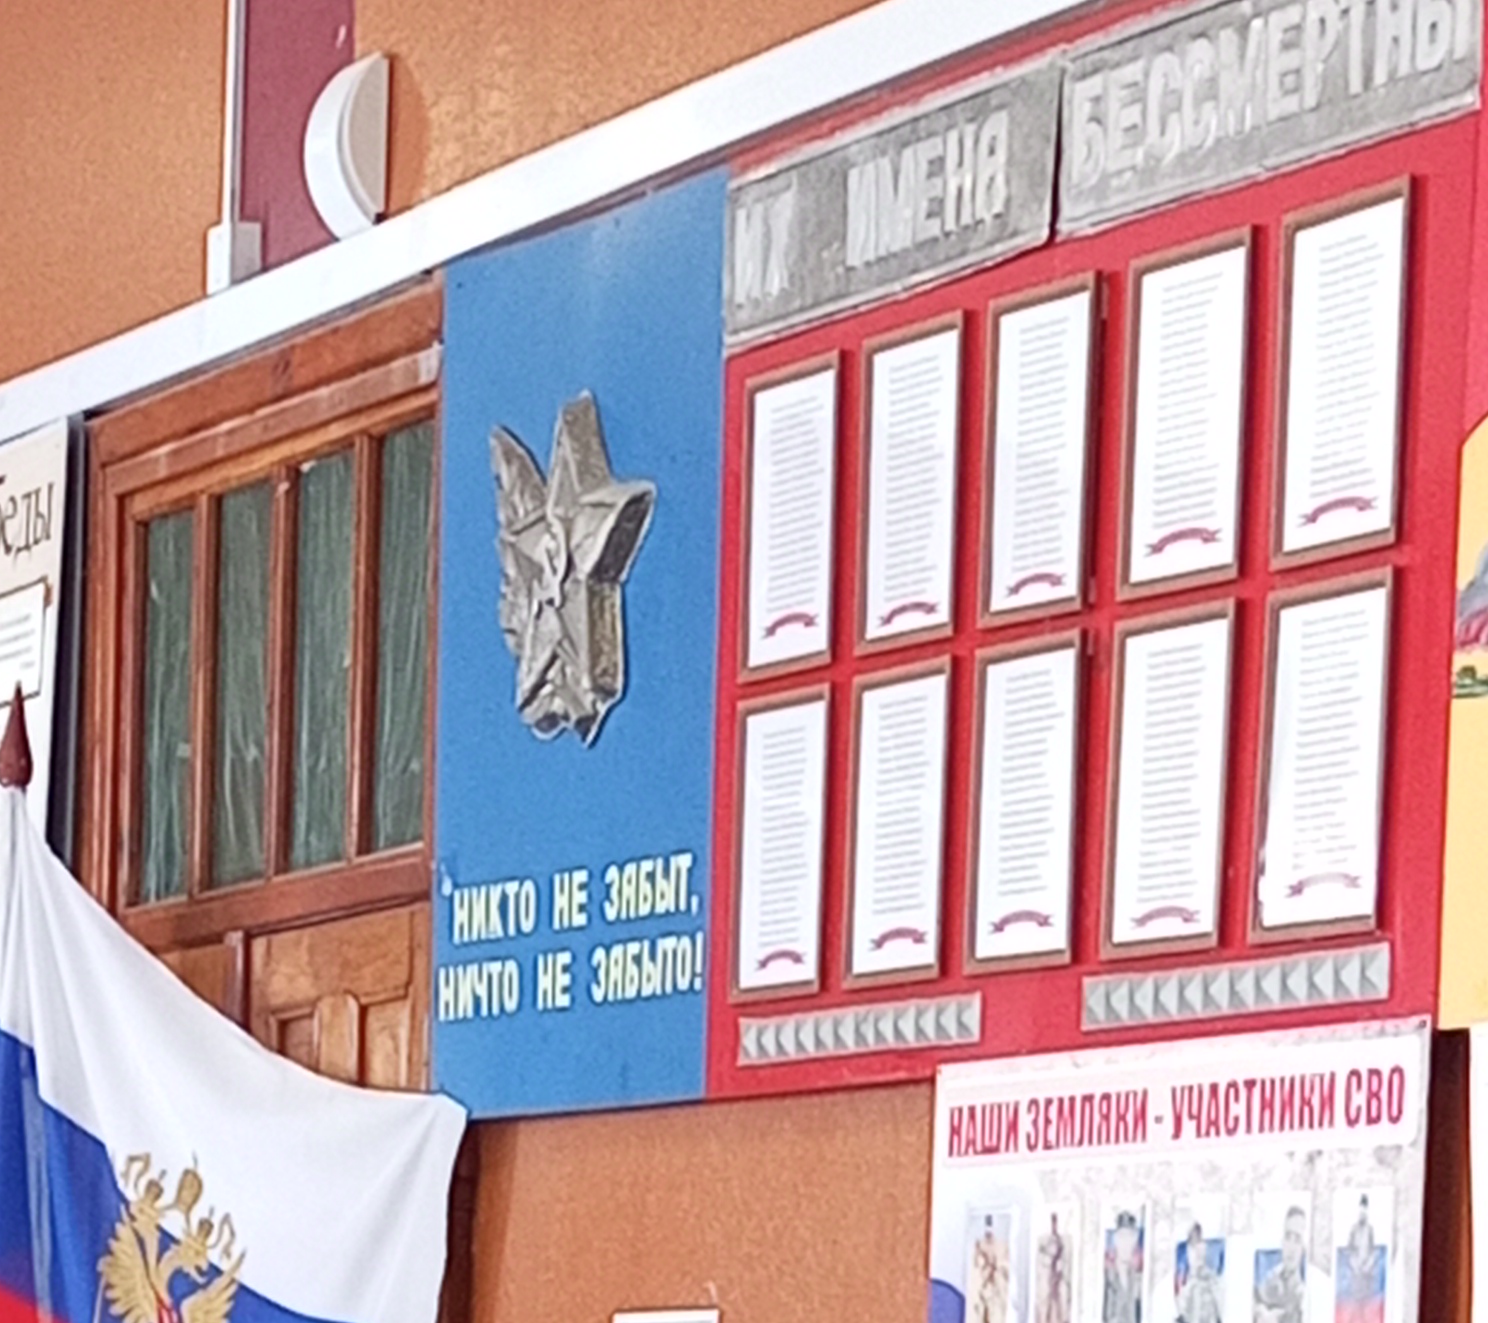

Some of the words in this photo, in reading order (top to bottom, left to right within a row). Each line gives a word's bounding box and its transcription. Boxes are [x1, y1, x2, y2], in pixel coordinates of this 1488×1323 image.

[733, 178, 797, 307] ИХ
[845, 107, 1008, 269] ИМЕНА
[1070, 0, 1470, 190] БЕССМЕРТНЫ
[452, 878, 537, 945] НИКТО
[552, 868, 589, 931] НЕ
[438, 958, 520, 1022] НИЧТО
[536, 950, 572, 1012] НЕ
[948, 1101, 1020, 1158] НАШИ
[1024, 1088, 1148, 1153] ЗЕМЛЯКИ
[1170, 1071, 1336, 1140] УЧАСТНИКИ
[1344, 1064, 1406, 1129] СВО
